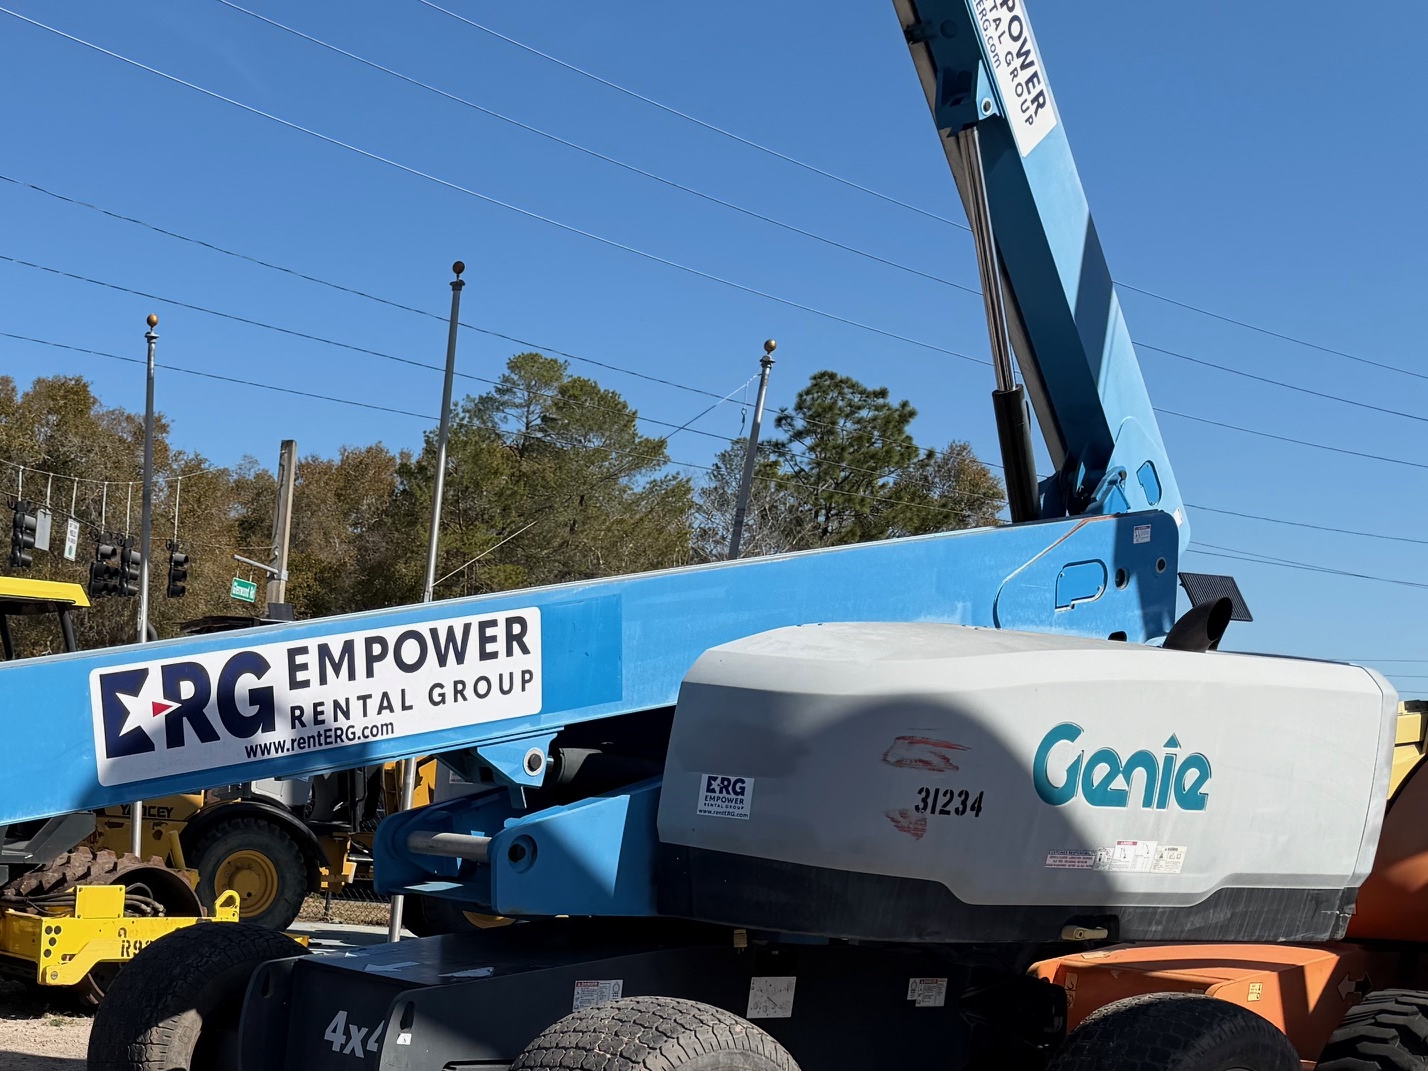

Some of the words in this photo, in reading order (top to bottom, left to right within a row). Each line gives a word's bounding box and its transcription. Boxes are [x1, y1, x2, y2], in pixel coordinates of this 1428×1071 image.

[1004, 51, 1034, 126] GROUP
[286, 616, 531, 691] EMPOWER
[100, 650, 276, 758] ERG
[289, 688, 415, 730] RENTAL
[428, 669, 534, 706] GROUP
[244, 719, 395, 759] www.rentERG.com
[1032, 721, 1212, 811] Genie
[704, 795, 745, 805] EMPOWER
[705, 775, 747, 797] ERG
[914, 786, 985, 818] 31234
